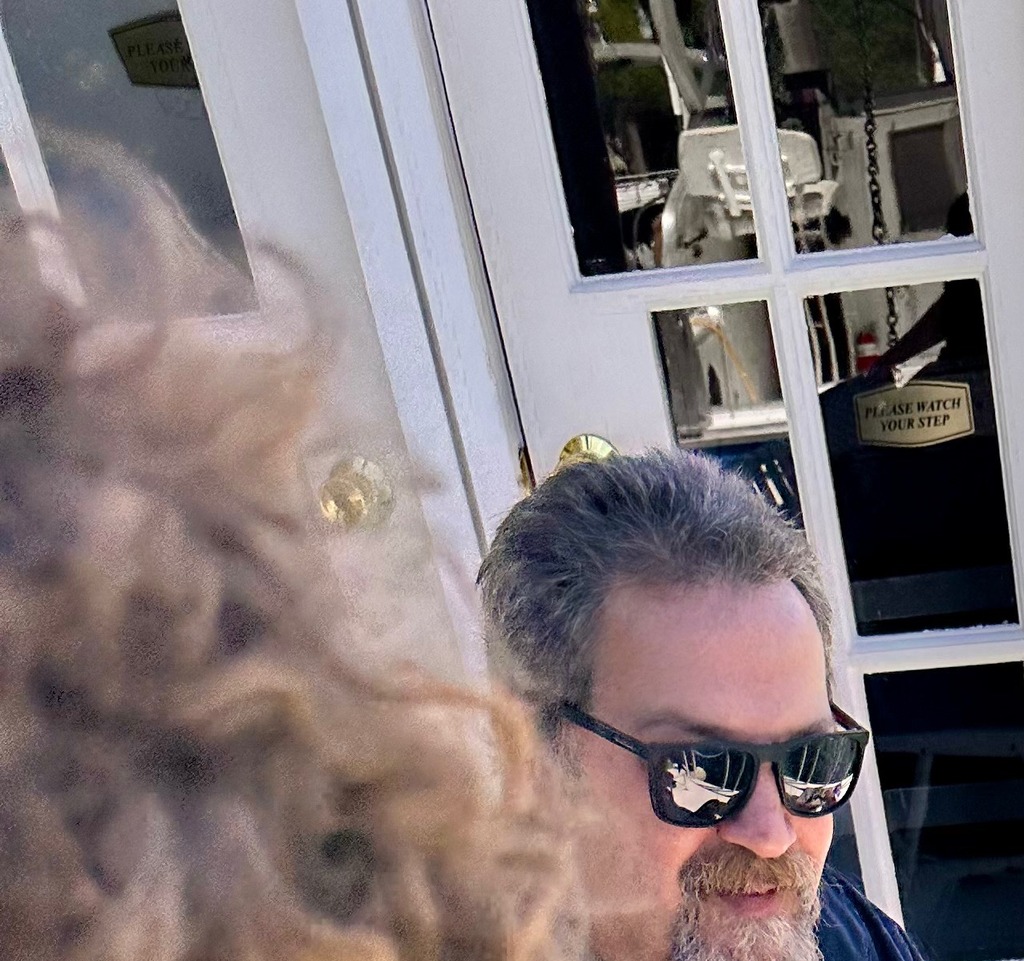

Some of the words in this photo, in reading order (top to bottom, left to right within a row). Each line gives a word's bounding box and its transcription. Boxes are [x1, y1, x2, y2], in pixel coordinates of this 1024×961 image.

[126, 38, 183, 57] PLEASE
[149, 57, 191, 73] YOUR
[865, 402, 913, 418] PLEASE
[917, 397, 961, 413] WATCH
[881, 419, 914, 432] YOUR
[919, 414, 950, 429] STEP
